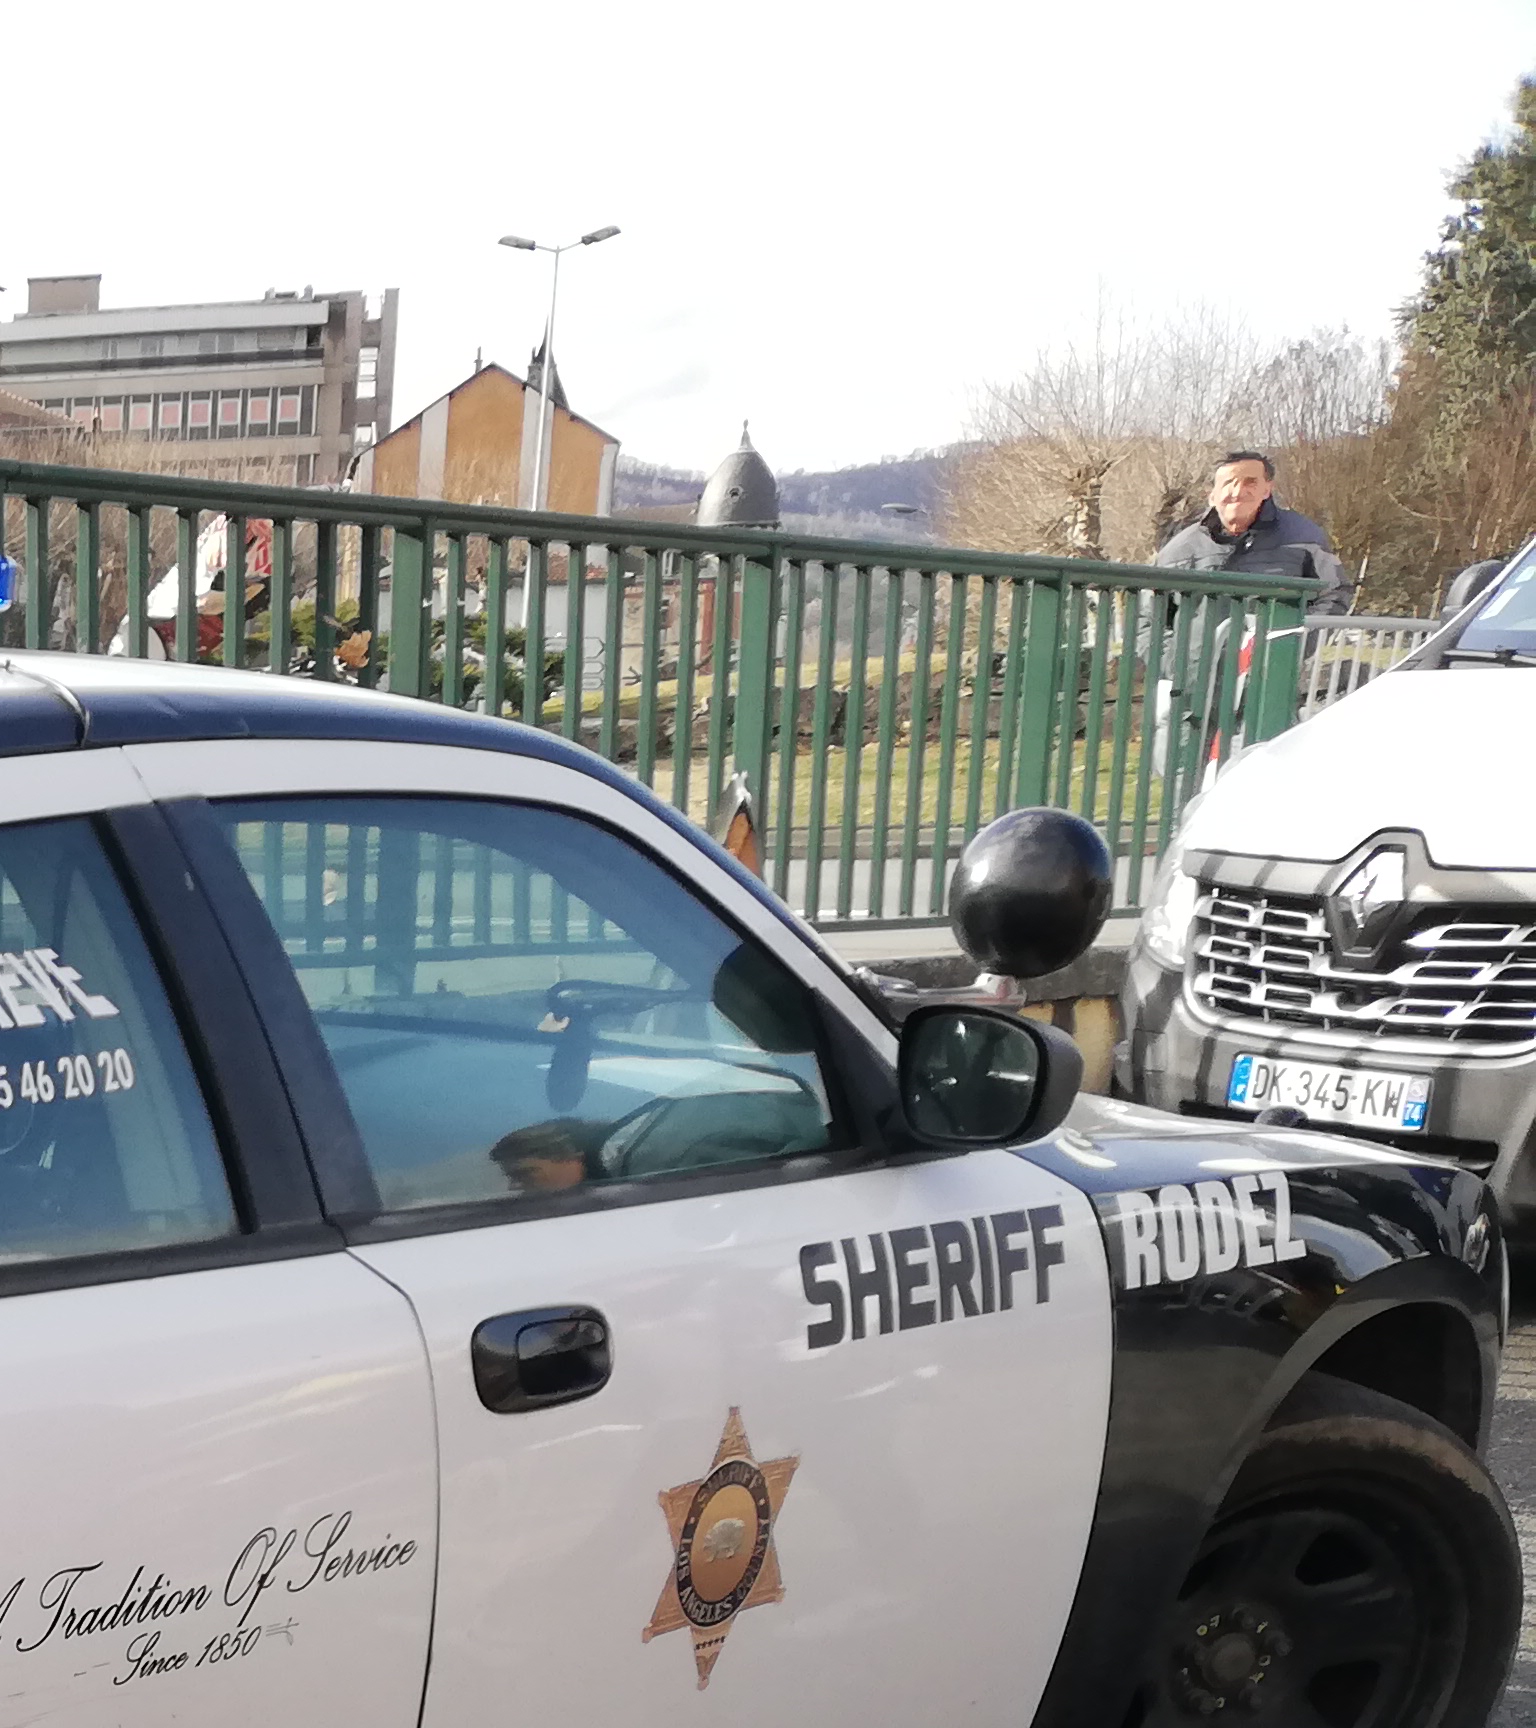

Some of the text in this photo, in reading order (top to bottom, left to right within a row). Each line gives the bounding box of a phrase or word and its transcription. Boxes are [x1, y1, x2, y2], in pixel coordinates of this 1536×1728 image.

[20, 1059, 56, 1104] 46
[57, 1054, 95, 1100] 20
[97, 1048, 135, 1093] 20
[798, 1204, 1066, 1350] SHERIFF
[1116, 1171, 1307, 1291] RODEZ
[16, 1560, 213, 1653] Tradition
[224, 1526, 298, 1628] Of
[286, 1510, 418, 1592] Service
[112, 1624, 263, 1686] Since 1850
